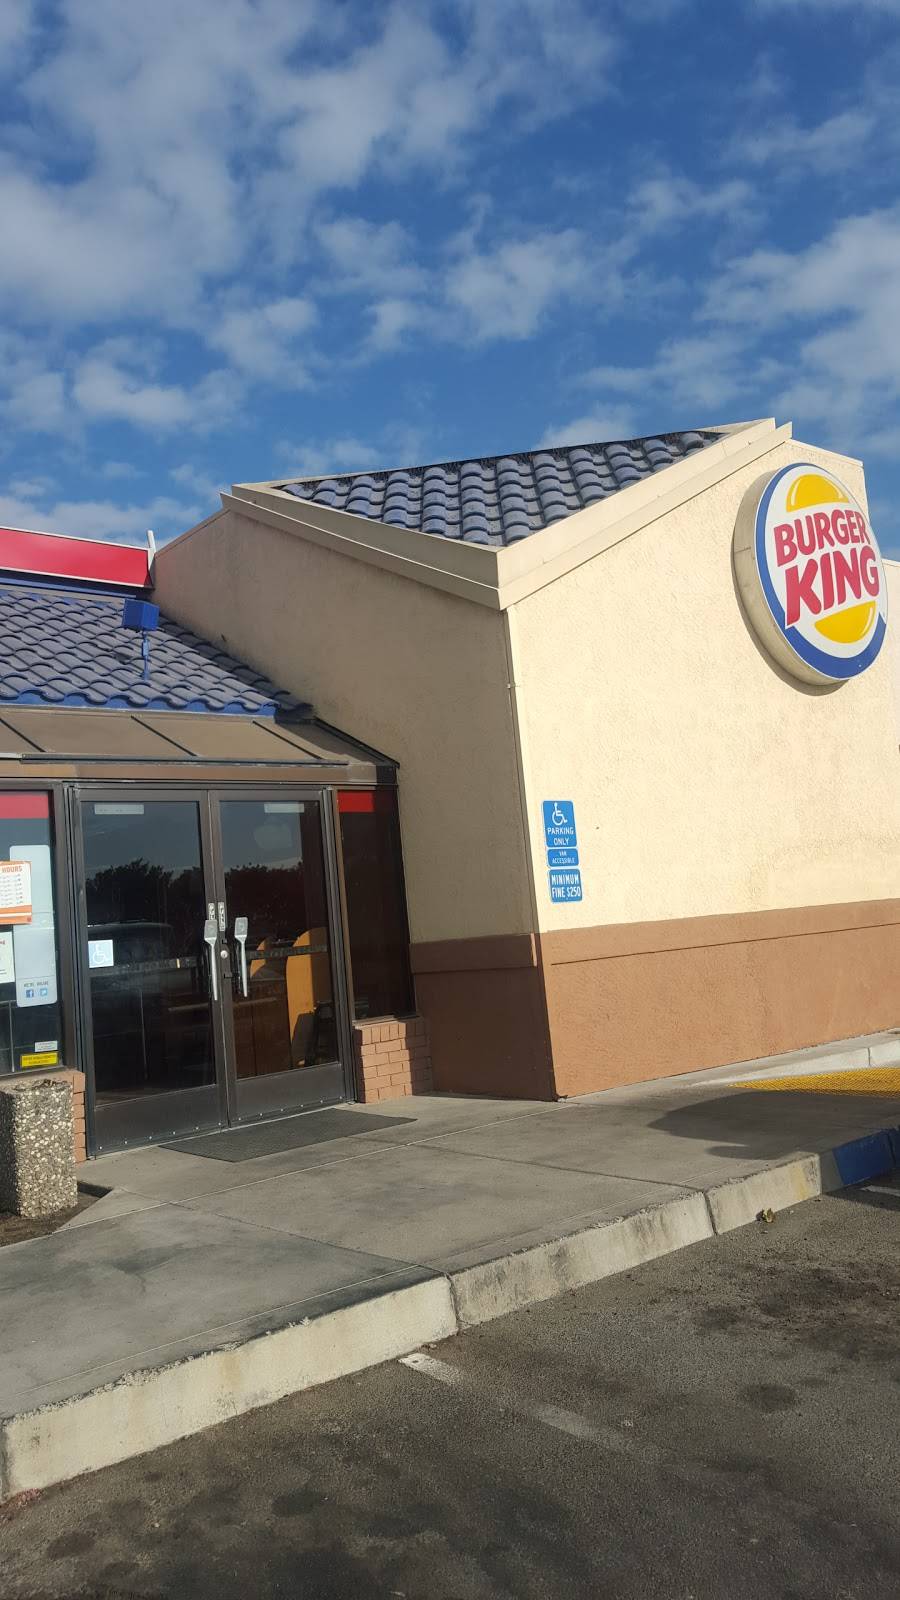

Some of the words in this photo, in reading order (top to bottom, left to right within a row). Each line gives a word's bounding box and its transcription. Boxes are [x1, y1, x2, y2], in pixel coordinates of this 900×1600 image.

[774, 509, 871, 567] BURGER
[785, 545, 880, 626] KING
[547, 827, 574, 835] PARKING
[553, 837, 569, 846] ONLY
[551, 874, 579, 885] MINIMUM
[552, 887, 566, 898] FINE
[566, 886, 581, 898] $250
